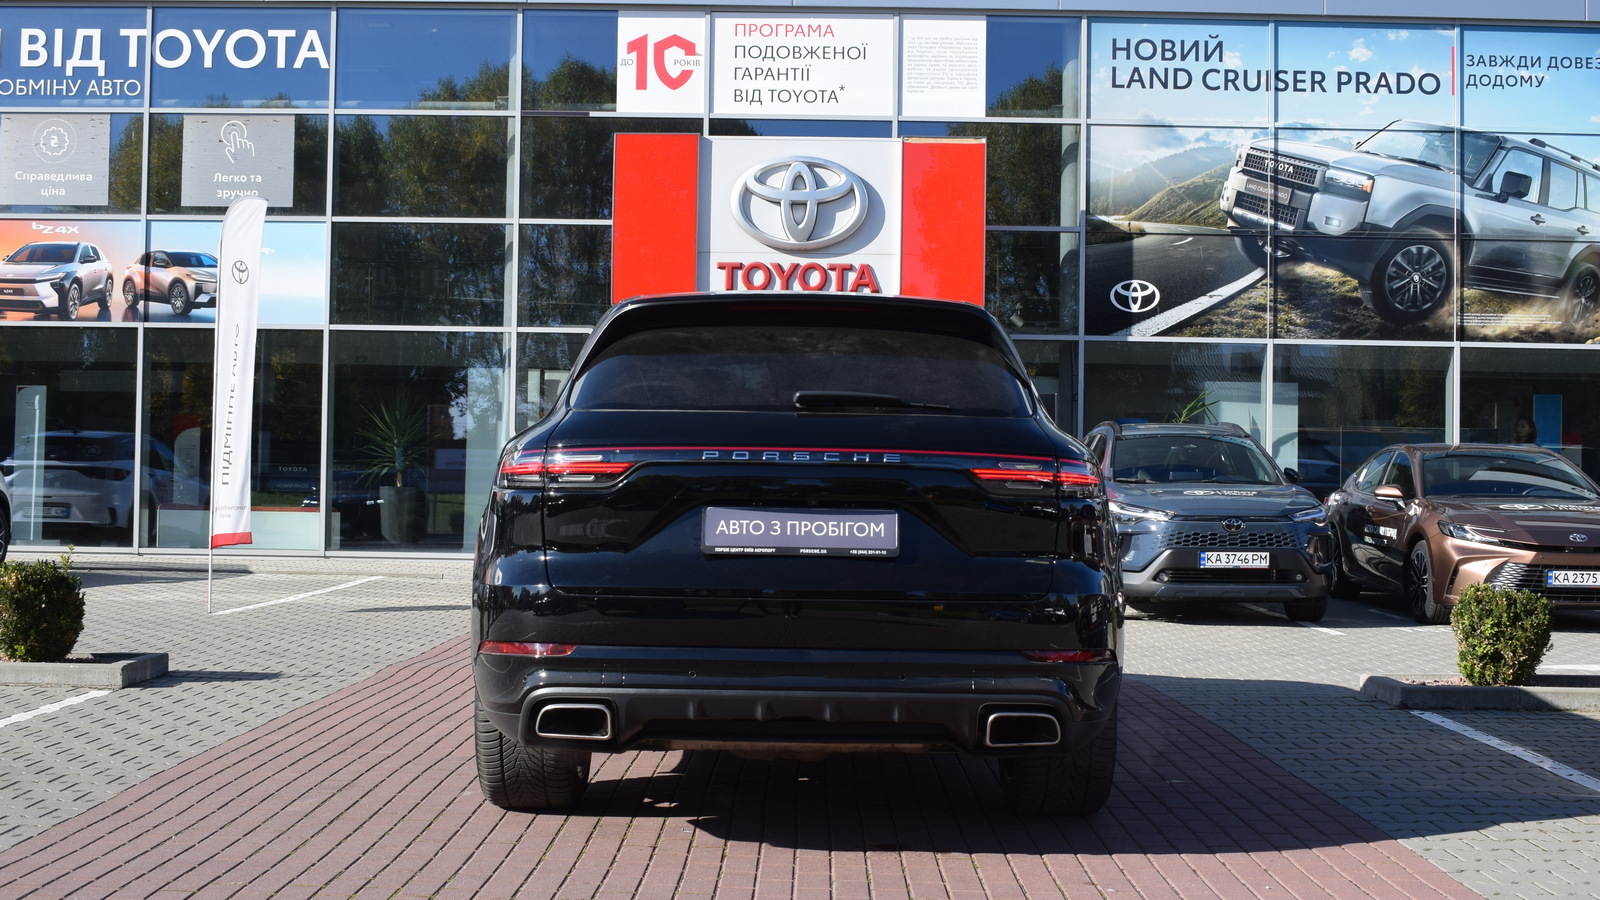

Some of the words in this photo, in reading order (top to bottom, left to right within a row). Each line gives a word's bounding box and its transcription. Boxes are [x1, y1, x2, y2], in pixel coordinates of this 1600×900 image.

[734, 23, 835, 38] ПРОГРАМА
[20, 28, 106, 77] ВІД
[120, 28, 331, 69] TOYOTA
[734, 43, 869, 62] ПОДОВЖЕНОЇ
[1111, 34, 1225, 62] НОВИЙ
[620, 58, 635, 67] ДО
[673, 59, 701, 67] РОКІВ
[1466, 54, 1542, 71] ЗАВЖДИ
[734, 64, 812, 82] ГАРАНТІЇ
[1111, 66, 1194, 90] LAND
[1202, 68, 1328, 93] CRUISER
[1336, 71, 1442, 96] PRADO
[0, 78, 81, 97] ОБМІНУ
[86, 79, 142, 97] АВТО
[1465, 74, 1545, 90] ДОДОМУ
[733, 88, 763, 106] ВІД
[15, 170, 93, 183] Справедлива
[213, 172, 248, 183] Легко
[250, 174, 262, 183] та
[40, 185, 66, 197] ціна
[216, 189, 259, 200] зручно
[716, 261, 881, 294] TOYOTA
[701, 450, 901, 463] PORSCHE
[716, 519, 765, 535] АВТО
[770, 520, 781, 535] З
[786, 520, 885, 537] ПРОБІГОМ
[1206, 553, 1222, 564] KA
[1224, 553, 1250, 564] 3746
[1251, 553, 1268, 564] PM
[1553, 572, 1570, 584] KA
[1572, 572, 1598, 584] 2375
